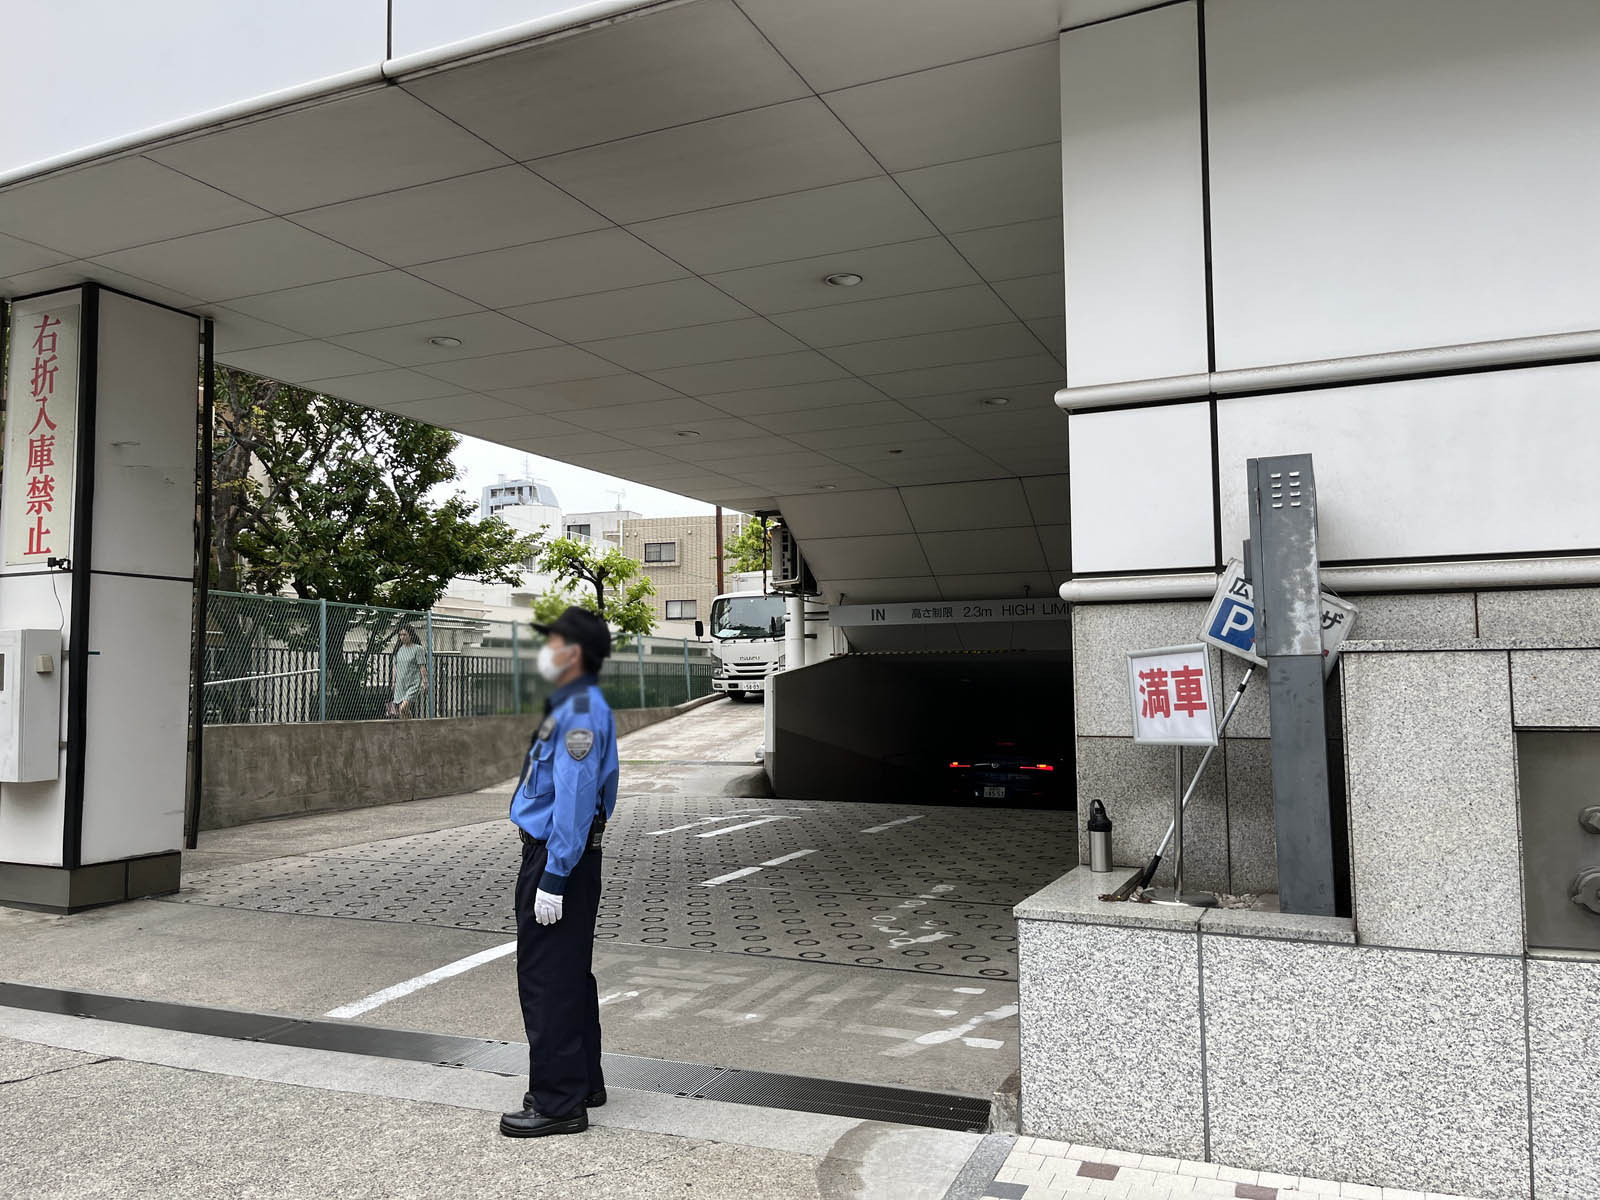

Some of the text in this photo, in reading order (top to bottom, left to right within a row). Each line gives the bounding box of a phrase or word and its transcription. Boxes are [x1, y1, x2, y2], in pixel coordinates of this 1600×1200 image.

[24, 314, 61, 556] 右折入庫禁止
[871, 608, 885, 621] IN
[911, 608, 953, 619] 高さ制限
[1002, 604, 1035, 616] HIGH
[1042, 602, 1071, 615] LIMI
[1220, 604, 1254, 637] P
[1138, 665, 1208, 719] 満車
